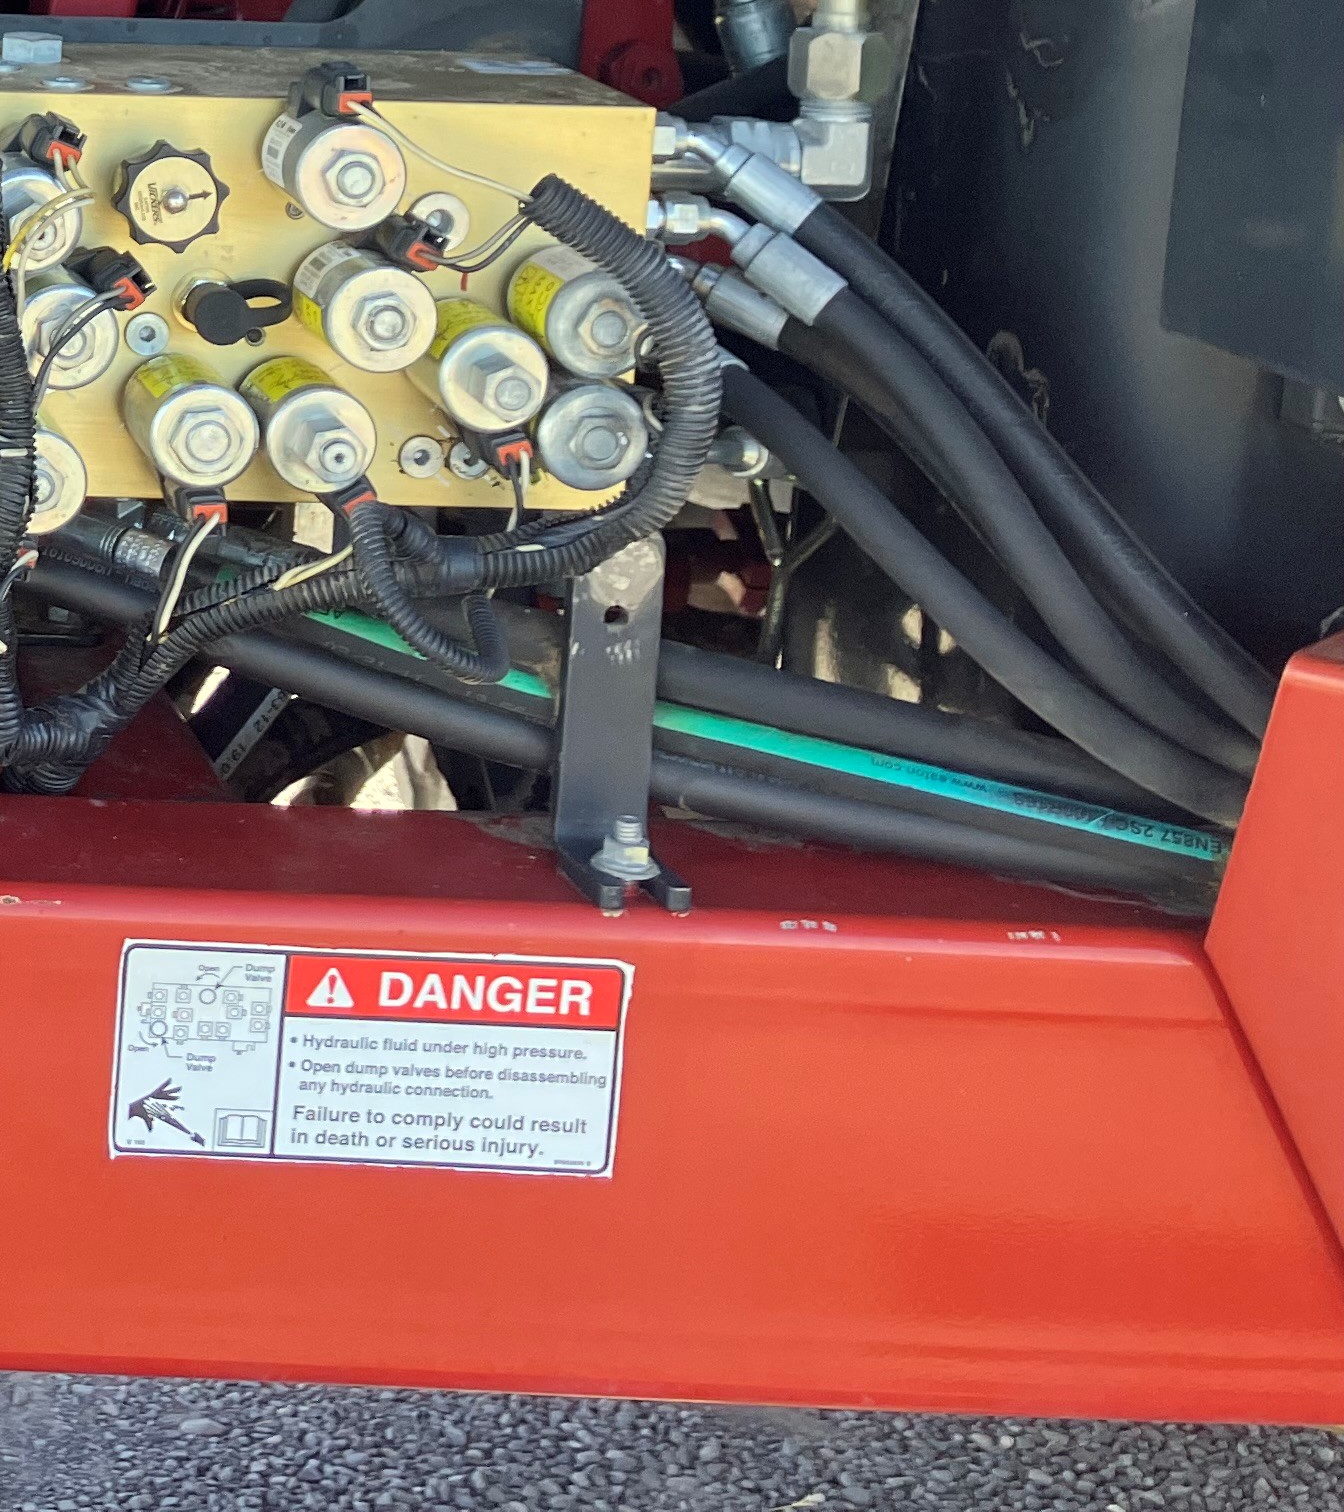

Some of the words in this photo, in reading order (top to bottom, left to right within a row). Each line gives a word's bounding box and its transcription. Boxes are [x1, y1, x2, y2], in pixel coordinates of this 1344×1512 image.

[147, 182, 164, 225] VICKERS
[198, 964, 220, 972] Open
[245, 964, 275, 974] Dump
[245, 973, 272, 982] Valve
[379, 971, 593, 1016] DANGER
[186, 1053, 216, 1063] Dump
[302, 1034, 378, 1051] Hydraulic
[383, 1037, 418, 1053] fluid
[423, 1040, 469, 1054] under
[473, 1042, 508, 1058] high
[512, 1046, 588, 1061] pressure.
[186, 1063, 213, 1071] Valve
[301, 1059, 341, 1075] Open
[345, 1062, 388, 1079] dump
[392, 1064, 441, 1079] valves
[445, 1066, 494, 1081] before
[497, 1068, 607, 1088] disassembling
[298, 1081, 326, 1094] any
[331, 1080, 401, 1097] hydraulic
[405, 1085, 494, 1100] connection.
[292, 1105, 361, 1123] Failure
[366, 1109, 386, 1124] to
[391, 1111, 464, 1132] comply
[470, 1115, 525, 1131] could
[530, 1117, 588, 1134] result
[291, 1129, 309, 1145] in
[315, 1129, 370, 1147] death
[376, 1136, 396, 1149] or
[402, 1135, 475, 1152] serious
[481, 1137, 545, 1159] injury.
